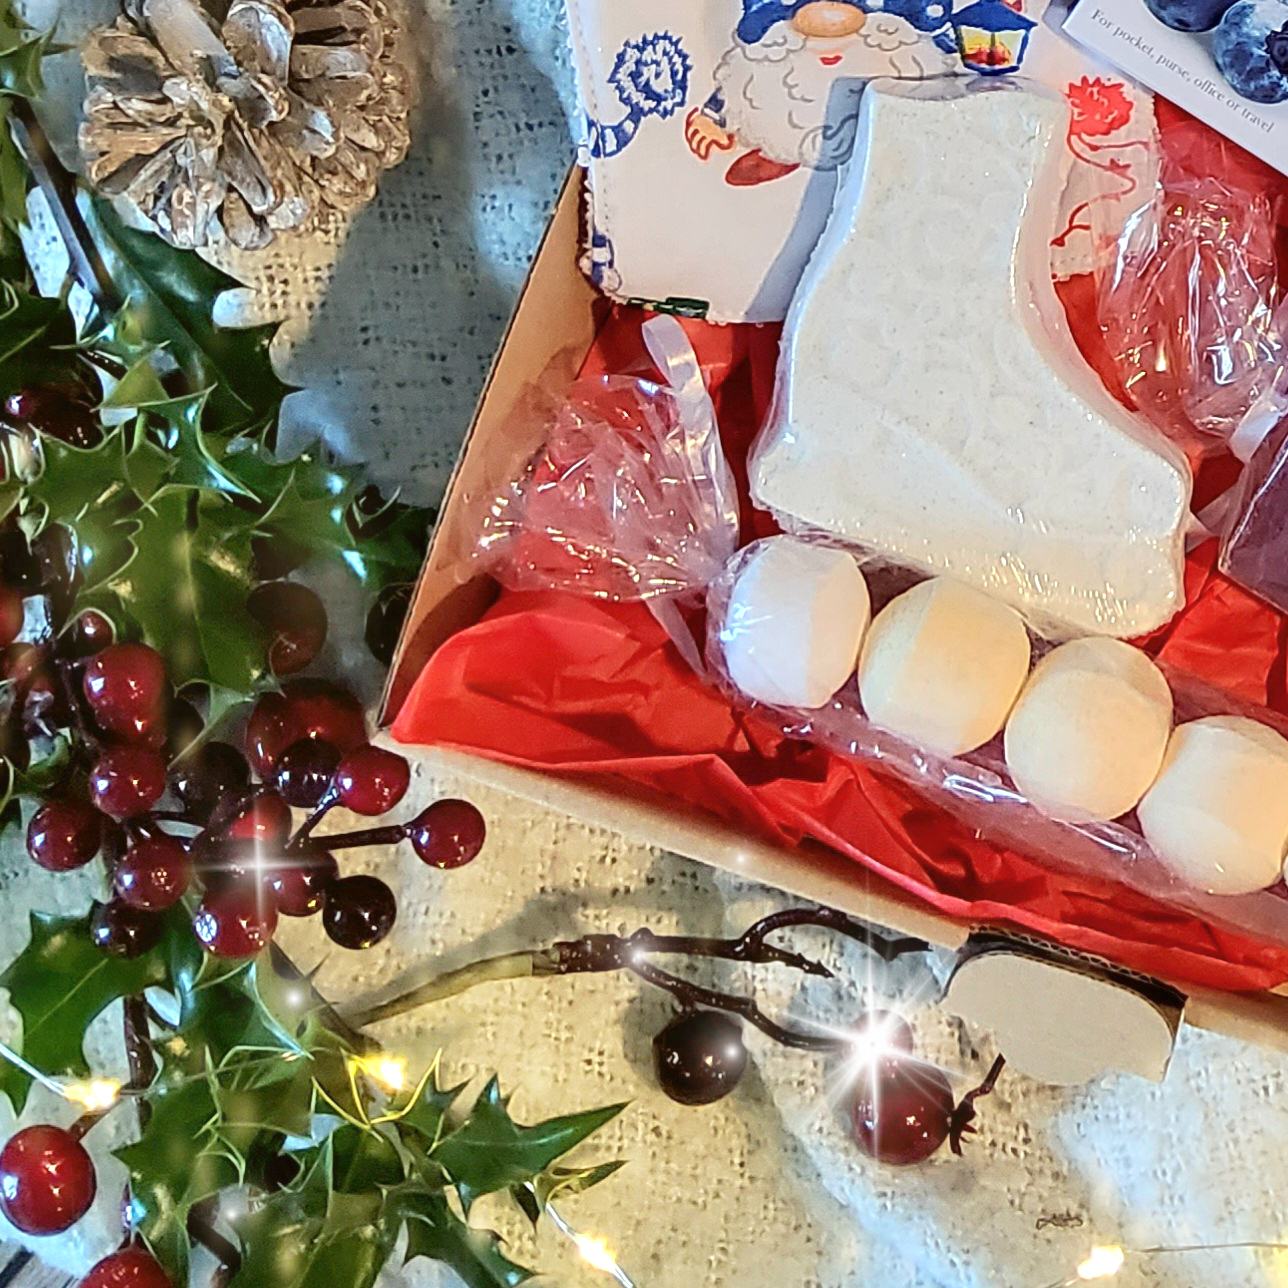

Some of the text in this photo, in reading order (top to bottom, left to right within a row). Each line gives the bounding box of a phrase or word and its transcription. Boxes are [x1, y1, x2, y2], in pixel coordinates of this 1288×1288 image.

[1090, 9, 1275, 133] For pocket, purse, office or travel
